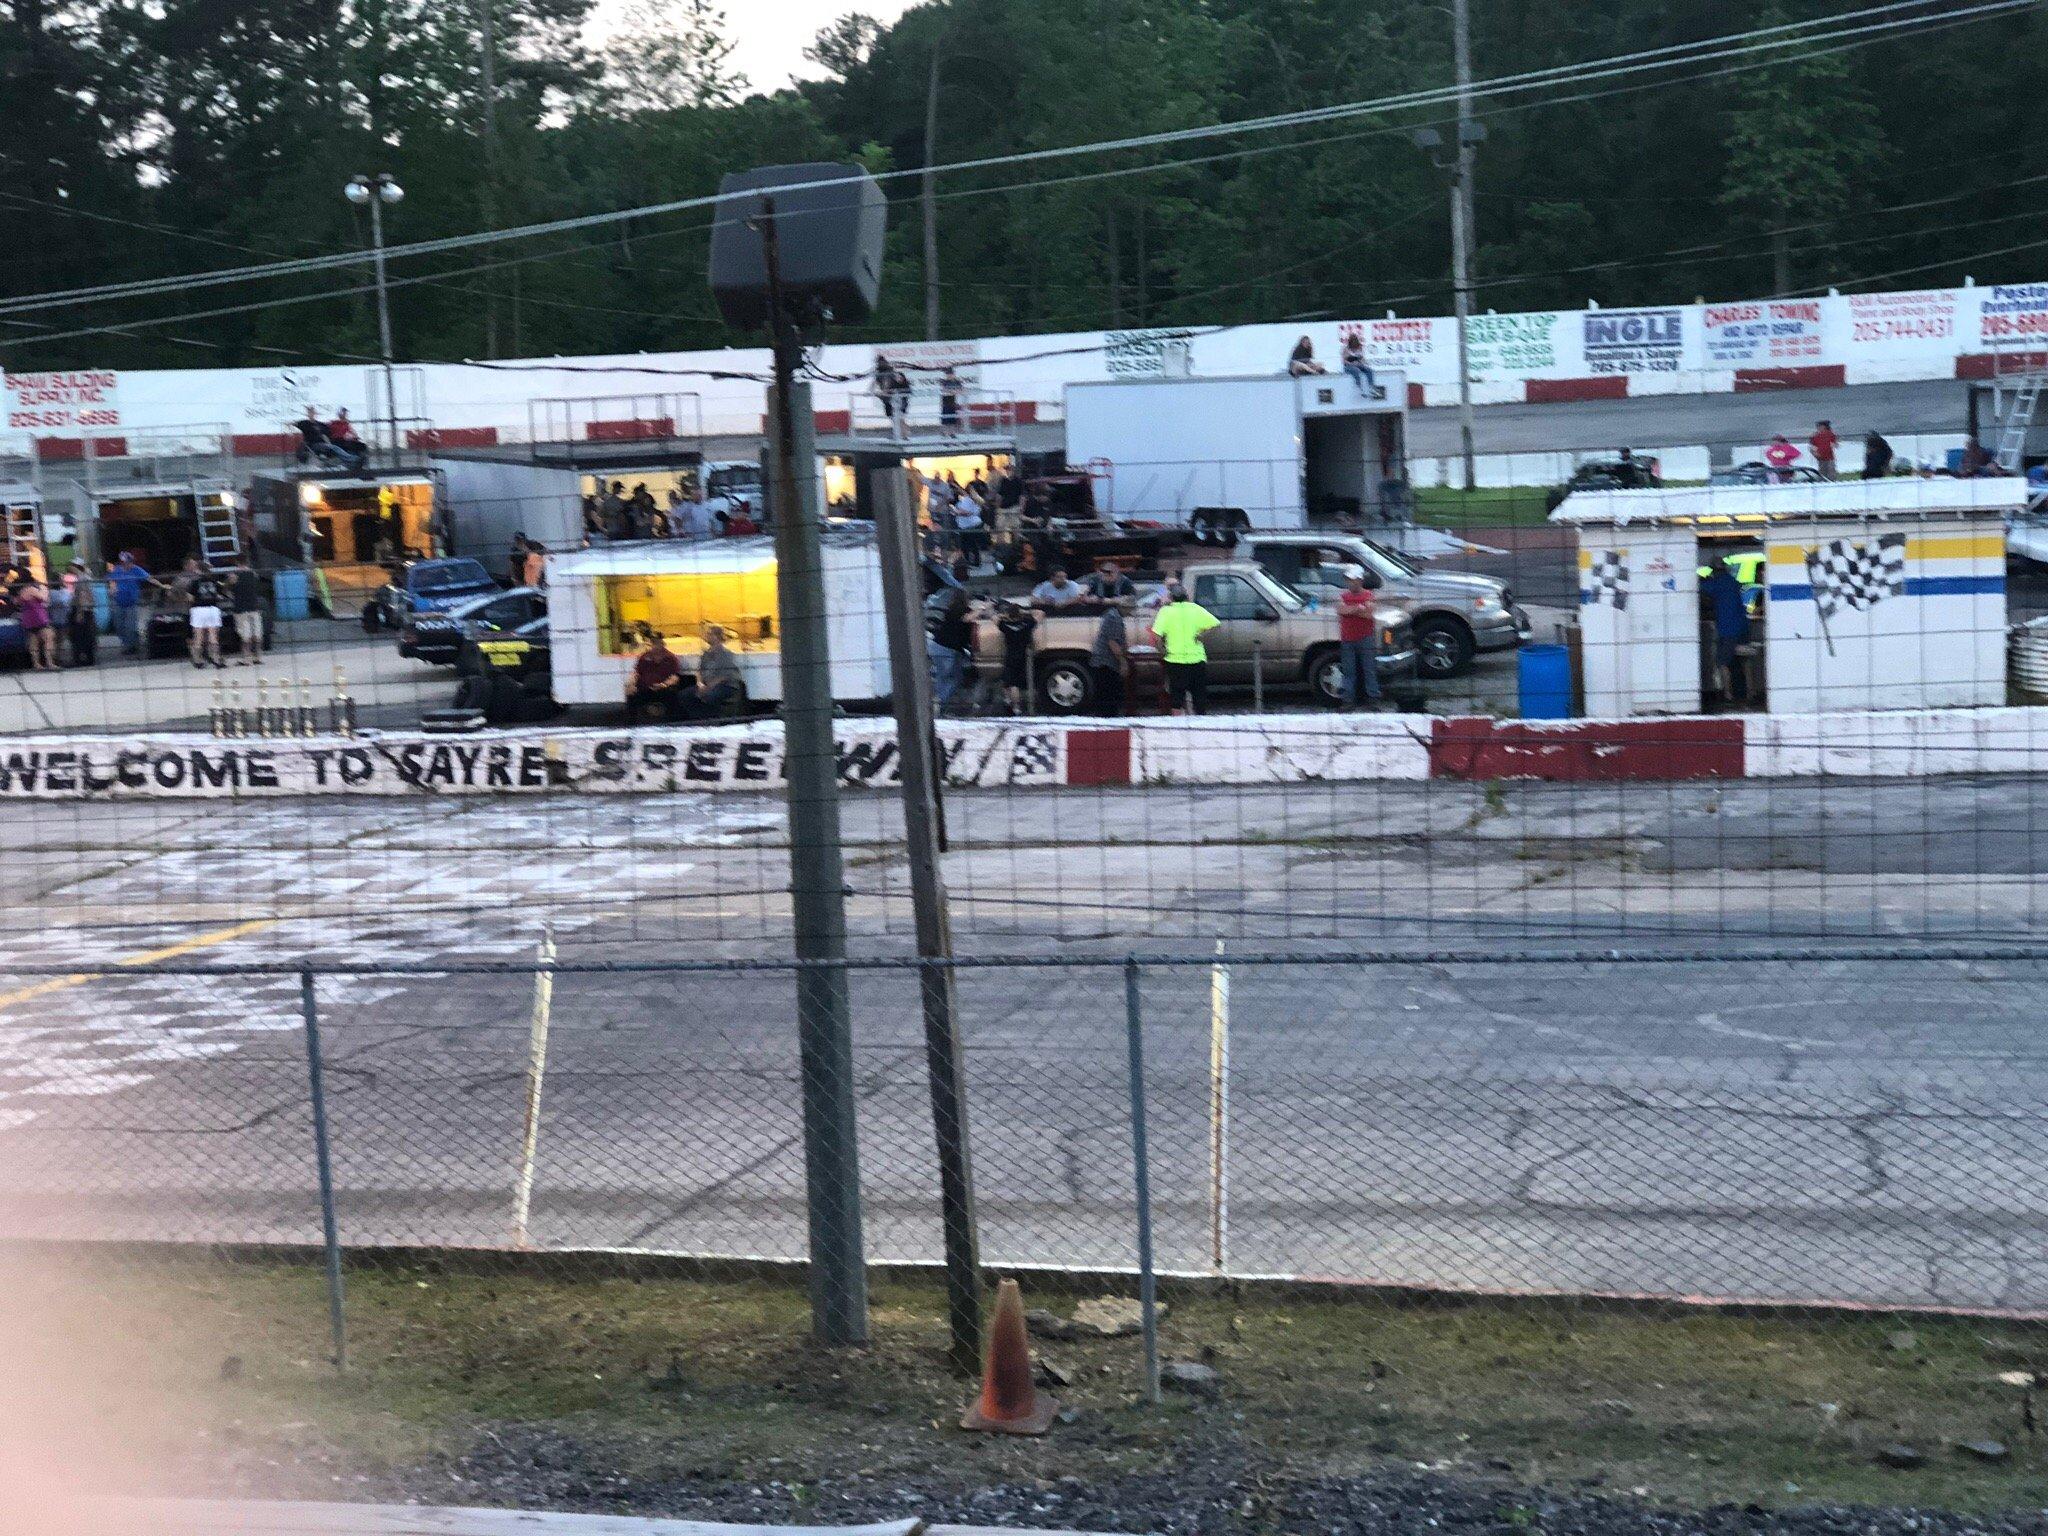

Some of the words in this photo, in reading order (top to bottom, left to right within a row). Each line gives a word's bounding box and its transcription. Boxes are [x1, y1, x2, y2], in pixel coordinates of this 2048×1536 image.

[1464, 317, 1517, 331] GREEN
[1523, 314, 1557, 328] TOP
[1584, 317, 1682, 343] INGLE
[1384, 342, 1432, 354] SALES
[0, 750, 279, 792] WELCOME
[305, 748, 374, 786] TO
[398, 744, 544, 788] SAYRE
[594, 738, 966, 786] SPEEWY
